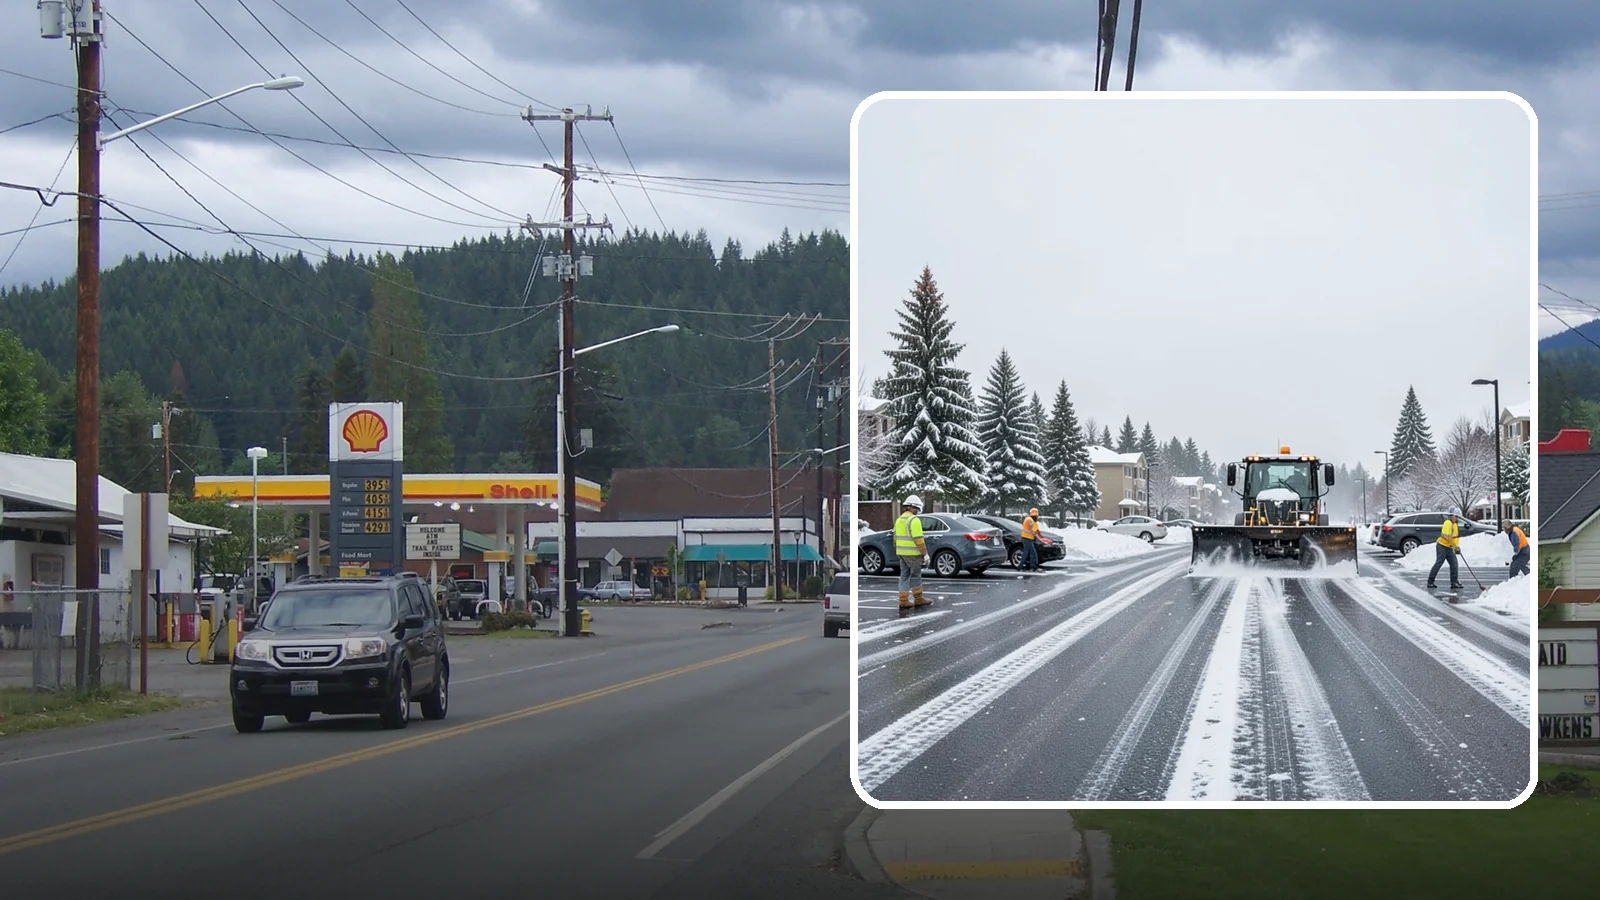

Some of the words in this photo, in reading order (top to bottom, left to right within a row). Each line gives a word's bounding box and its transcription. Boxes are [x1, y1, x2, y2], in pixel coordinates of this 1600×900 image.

[366, 480, 383, 490] 395
[490, 484, 547, 498] Shell
[366, 494, 383, 504] 405
[366, 508, 383, 518] 415
[366, 522, 383, 533] 429
